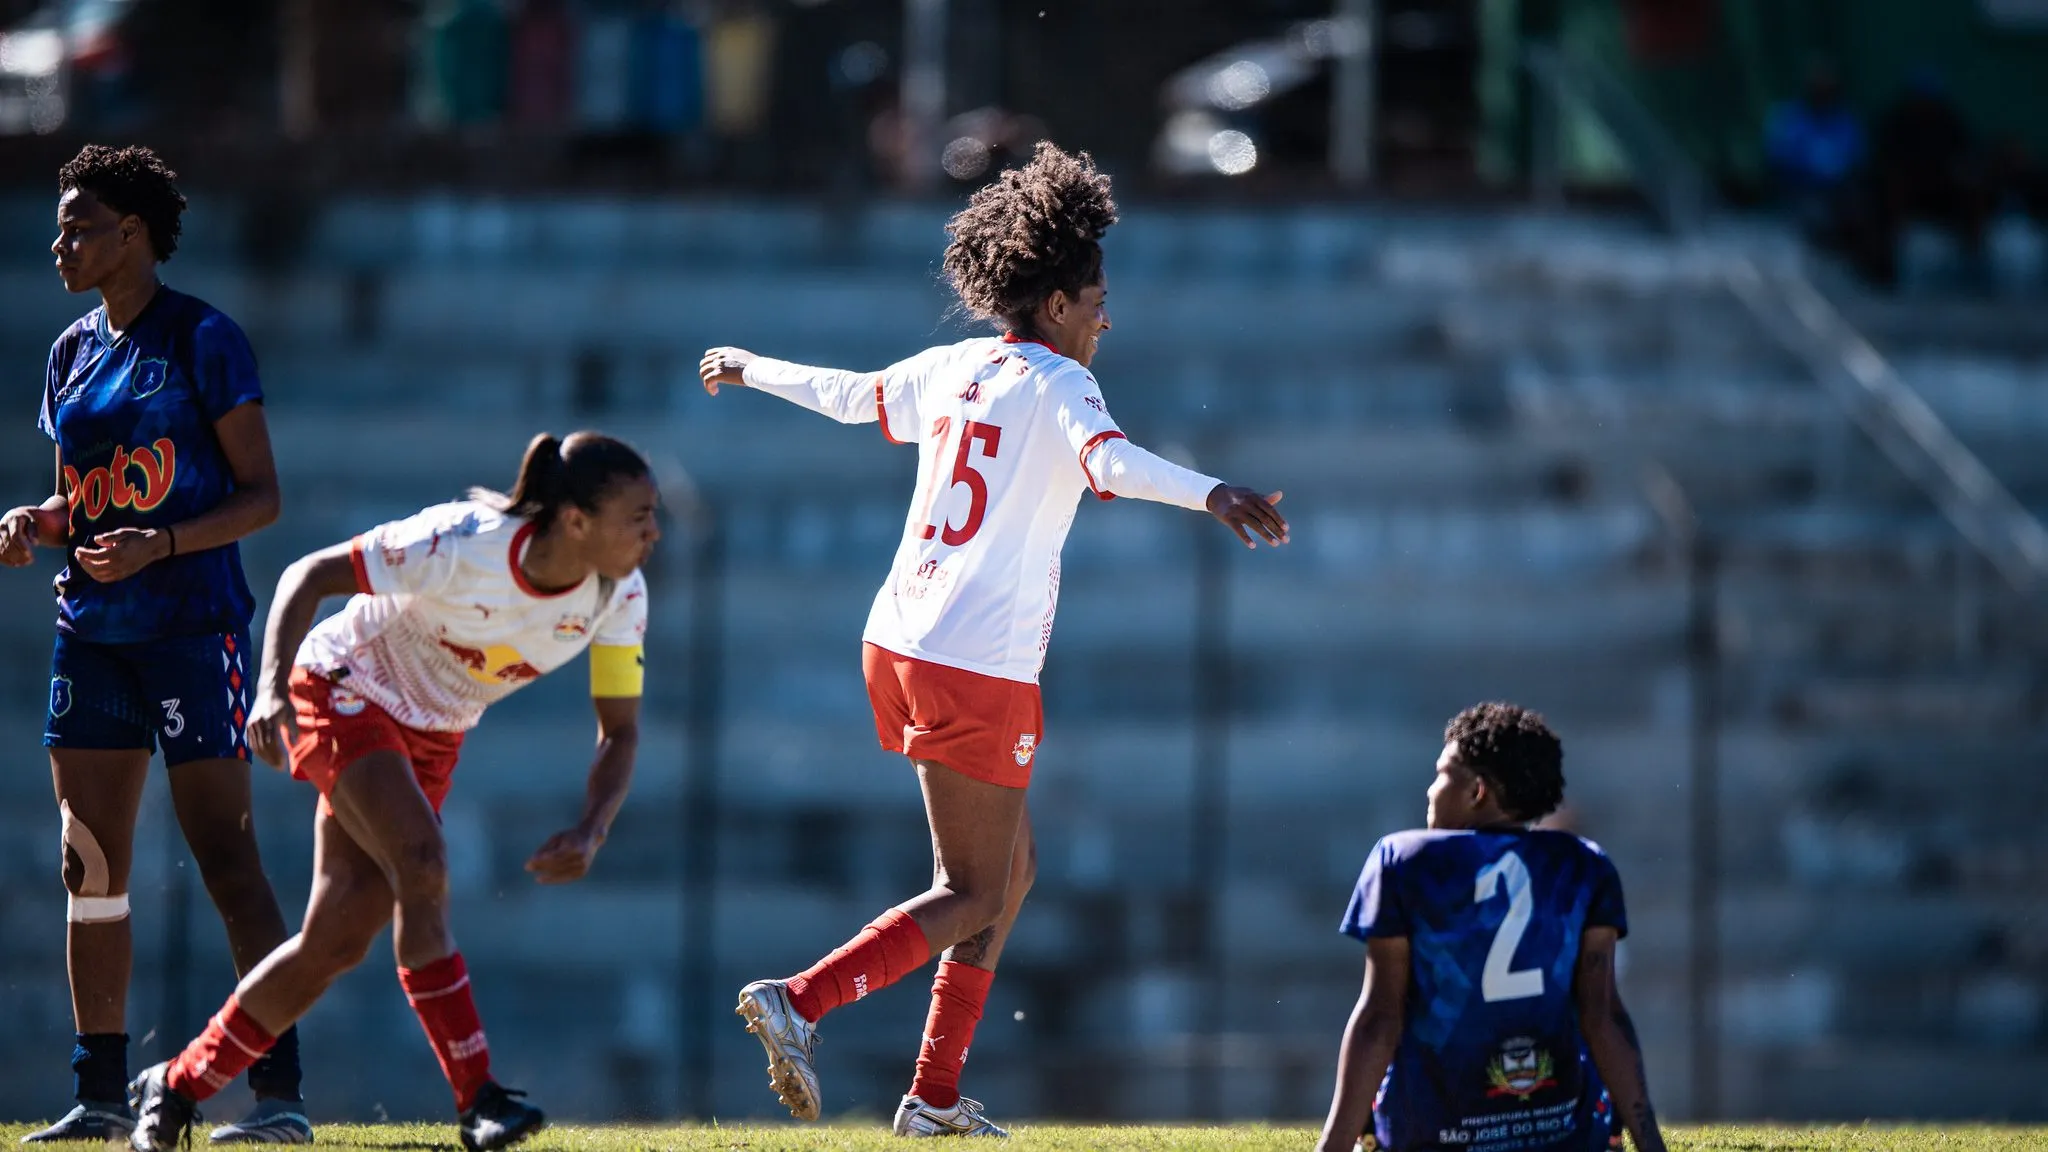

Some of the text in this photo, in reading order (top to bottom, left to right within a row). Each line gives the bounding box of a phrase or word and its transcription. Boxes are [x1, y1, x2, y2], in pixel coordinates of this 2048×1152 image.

[64, 437, 175, 536] Poty
[913, 415, 1002, 546] 15
[161, 698, 184, 738] 3
[1474, 851, 1545, 1003] 2
[1438, 1127, 1471, 1144] SÃO
[1512, 1120, 1533, 1136] DO
[1536, 1117, 1562, 1131] RIO
